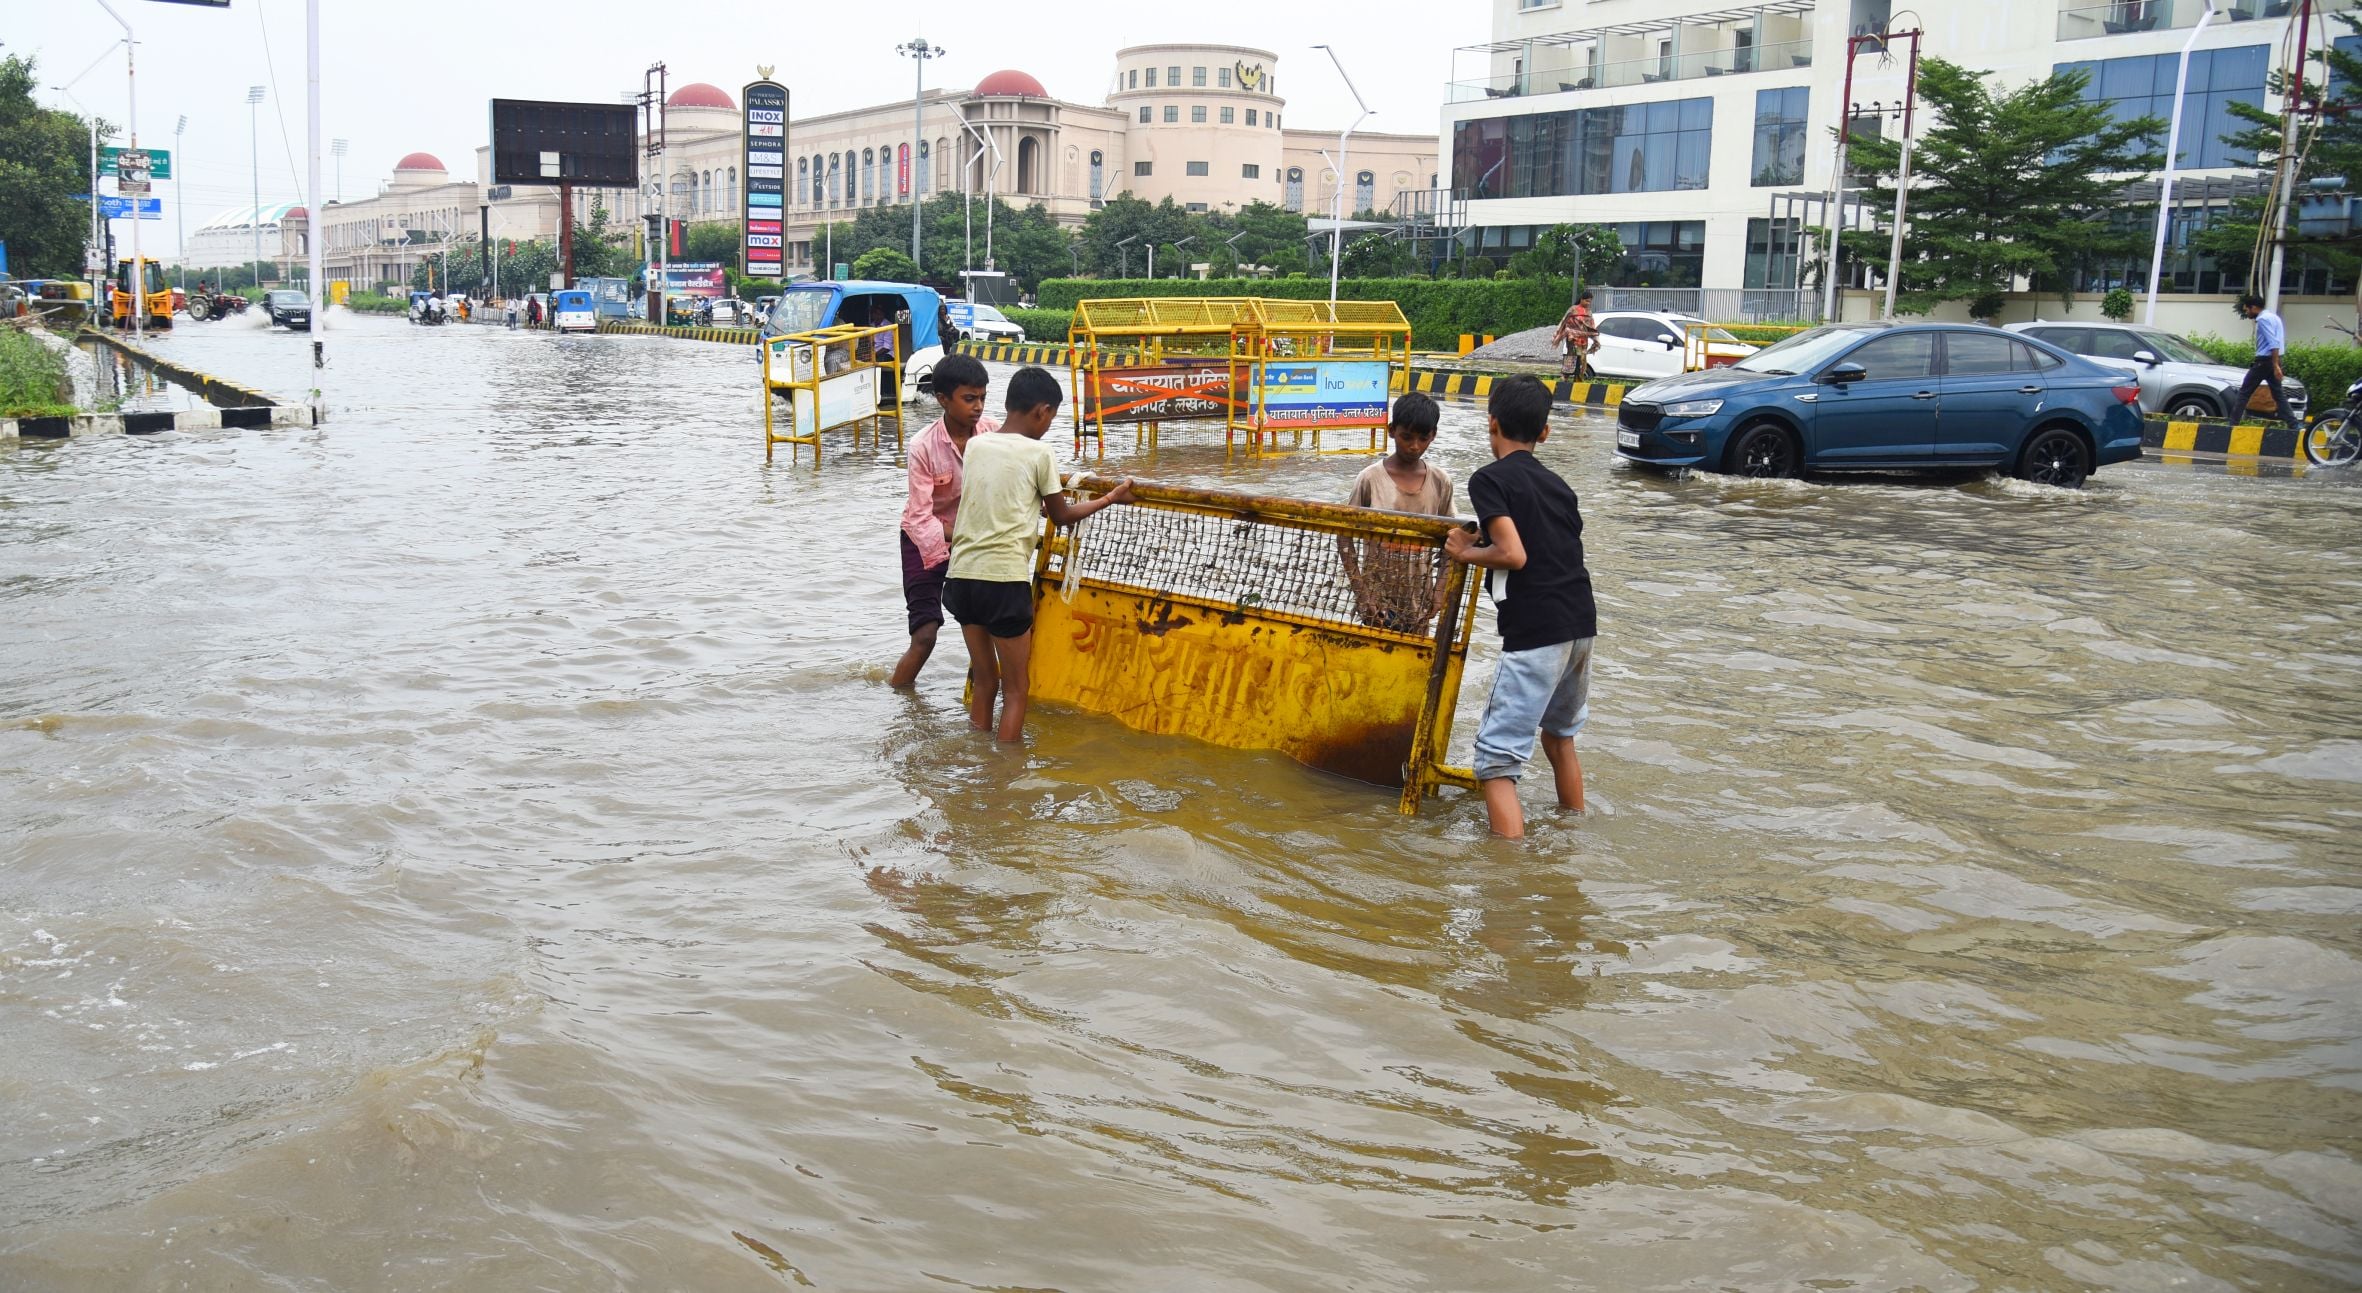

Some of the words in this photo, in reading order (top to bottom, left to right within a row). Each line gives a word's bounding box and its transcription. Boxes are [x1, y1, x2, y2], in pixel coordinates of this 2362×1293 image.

[749, 97, 784, 106] PALASSIO
[752, 111, 780, 121] INOX
[754, 153, 777, 162] M&S
[750, 236, 779, 246] max
[1175, 397, 1218, 413] लखनऊ
[1269, 409, 1309, 420] यातायात
[1363, 404, 1384, 418] प्रदेश
